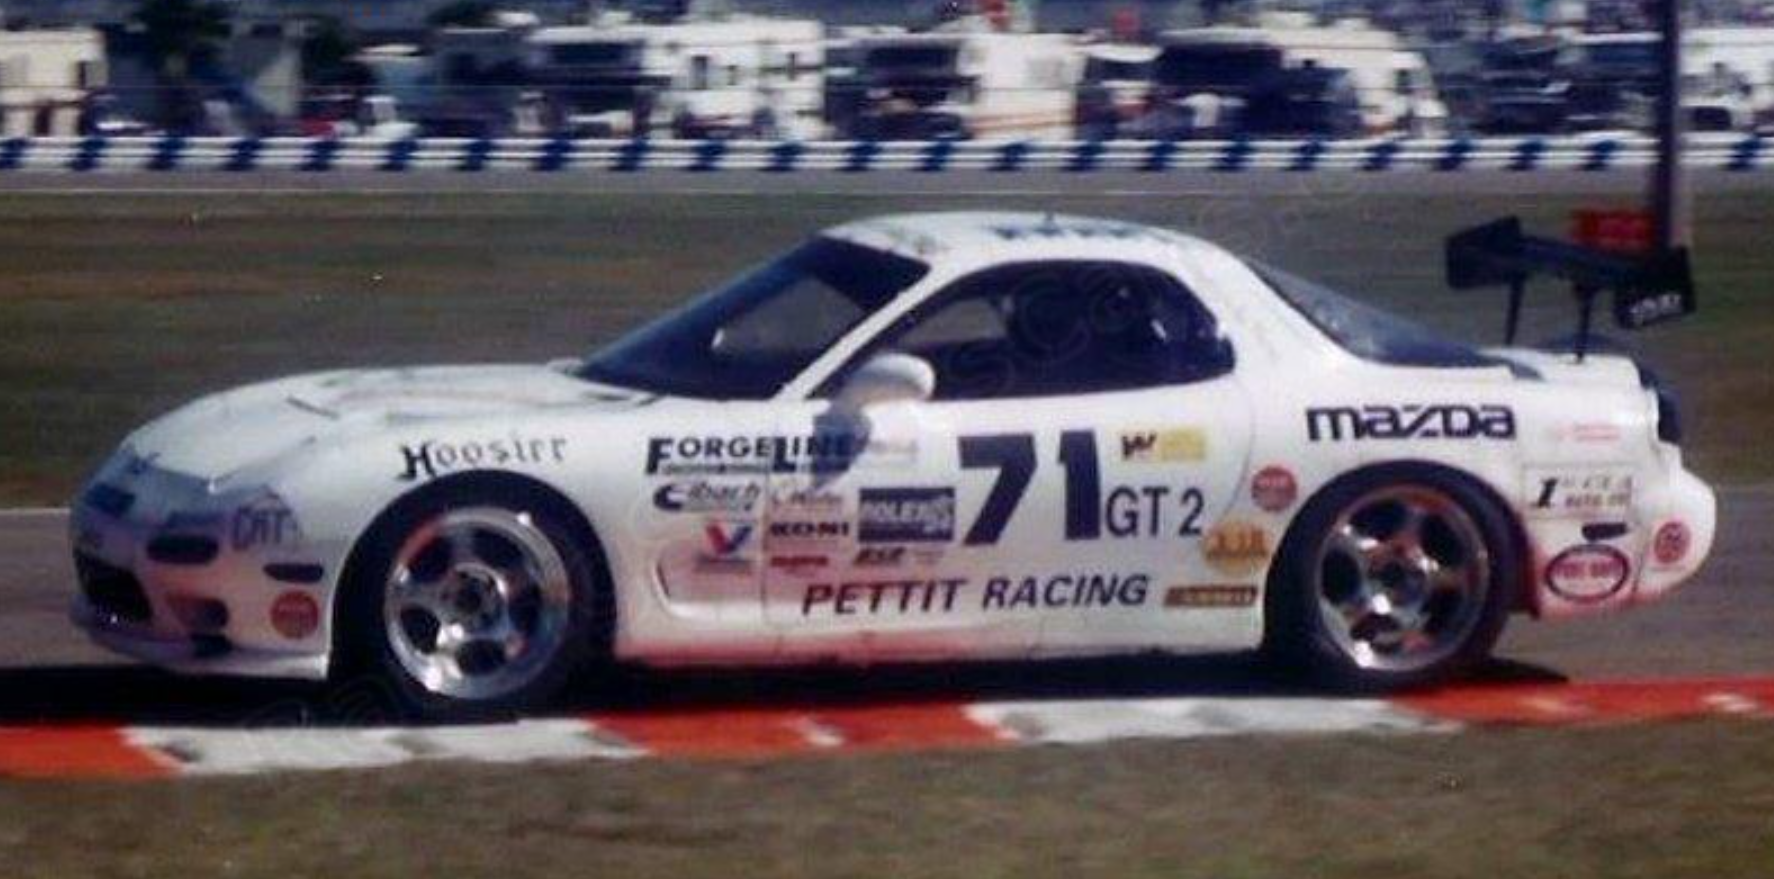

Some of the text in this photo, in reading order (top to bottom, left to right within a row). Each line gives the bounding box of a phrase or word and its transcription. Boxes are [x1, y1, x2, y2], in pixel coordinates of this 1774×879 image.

[957, 429, 1102, 546] 71
[1106, 486, 1168, 537] GT
[1179, 486, 1206, 537] 2
[802, 576, 970, 616] PETTIT
[981, 573, 1150, 613] RACING
